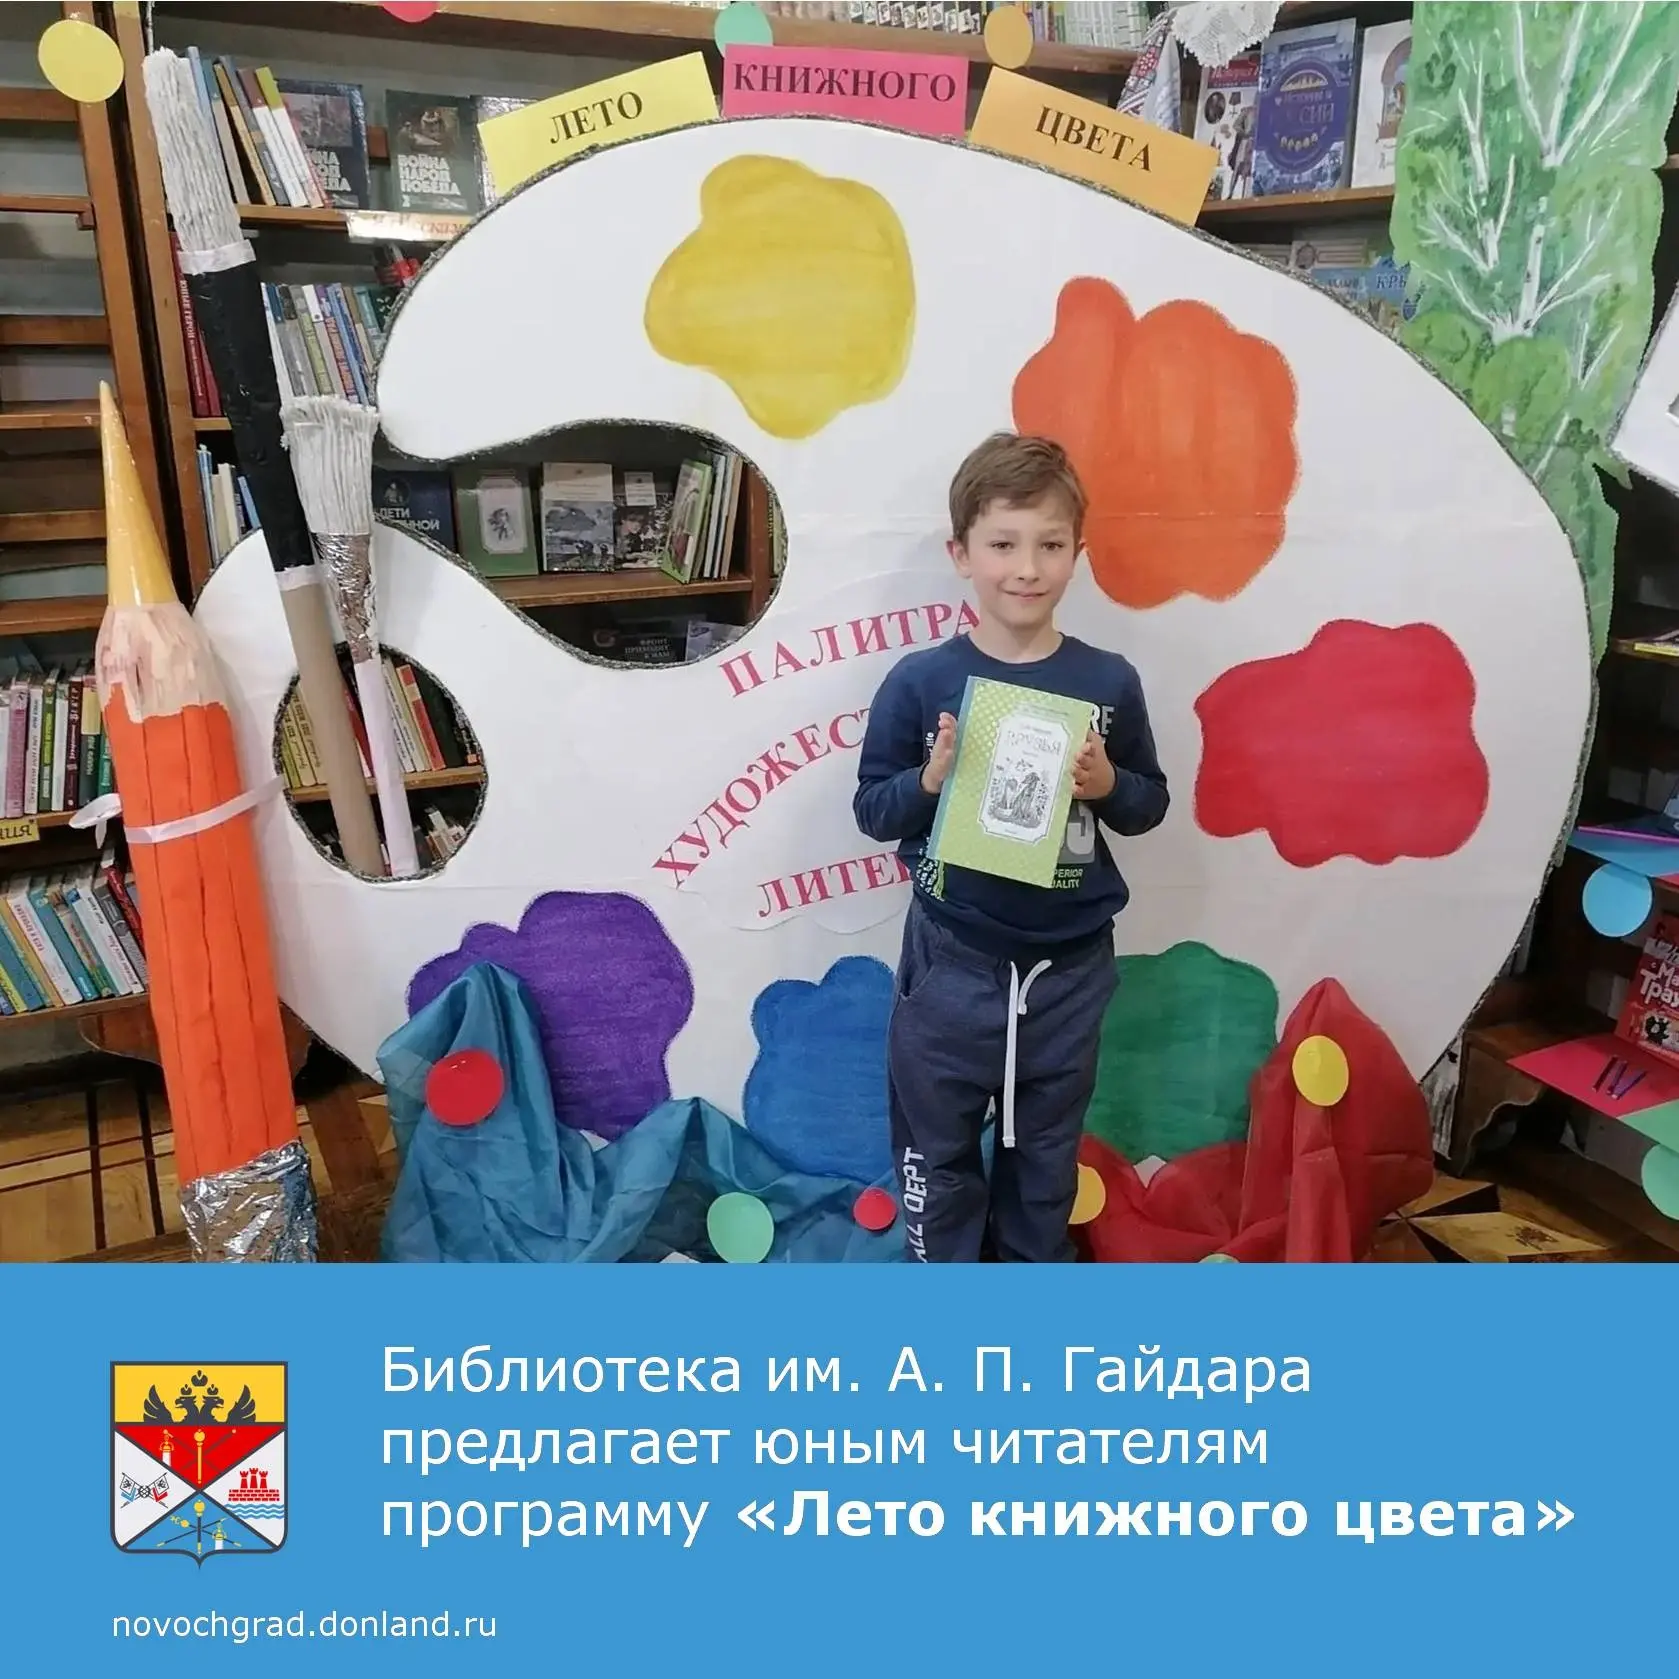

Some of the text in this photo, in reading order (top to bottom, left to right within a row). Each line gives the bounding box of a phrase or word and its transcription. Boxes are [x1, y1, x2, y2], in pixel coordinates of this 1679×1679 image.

[735, 63, 956, 102] КНИЖНОГО
[550, 91, 642, 144] ЛЕТО
[1035, 106, 1151, 172] ЦВЕТА
[398, 154, 450, 169] ВОЙНА
[400, 167, 451, 182] НАРОД
[401, 180, 461, 195] ПОБЕДА
[380, 508, 410, 518] ДЕТИ
[719, 599, 980, 697] ПАЛИТРА
